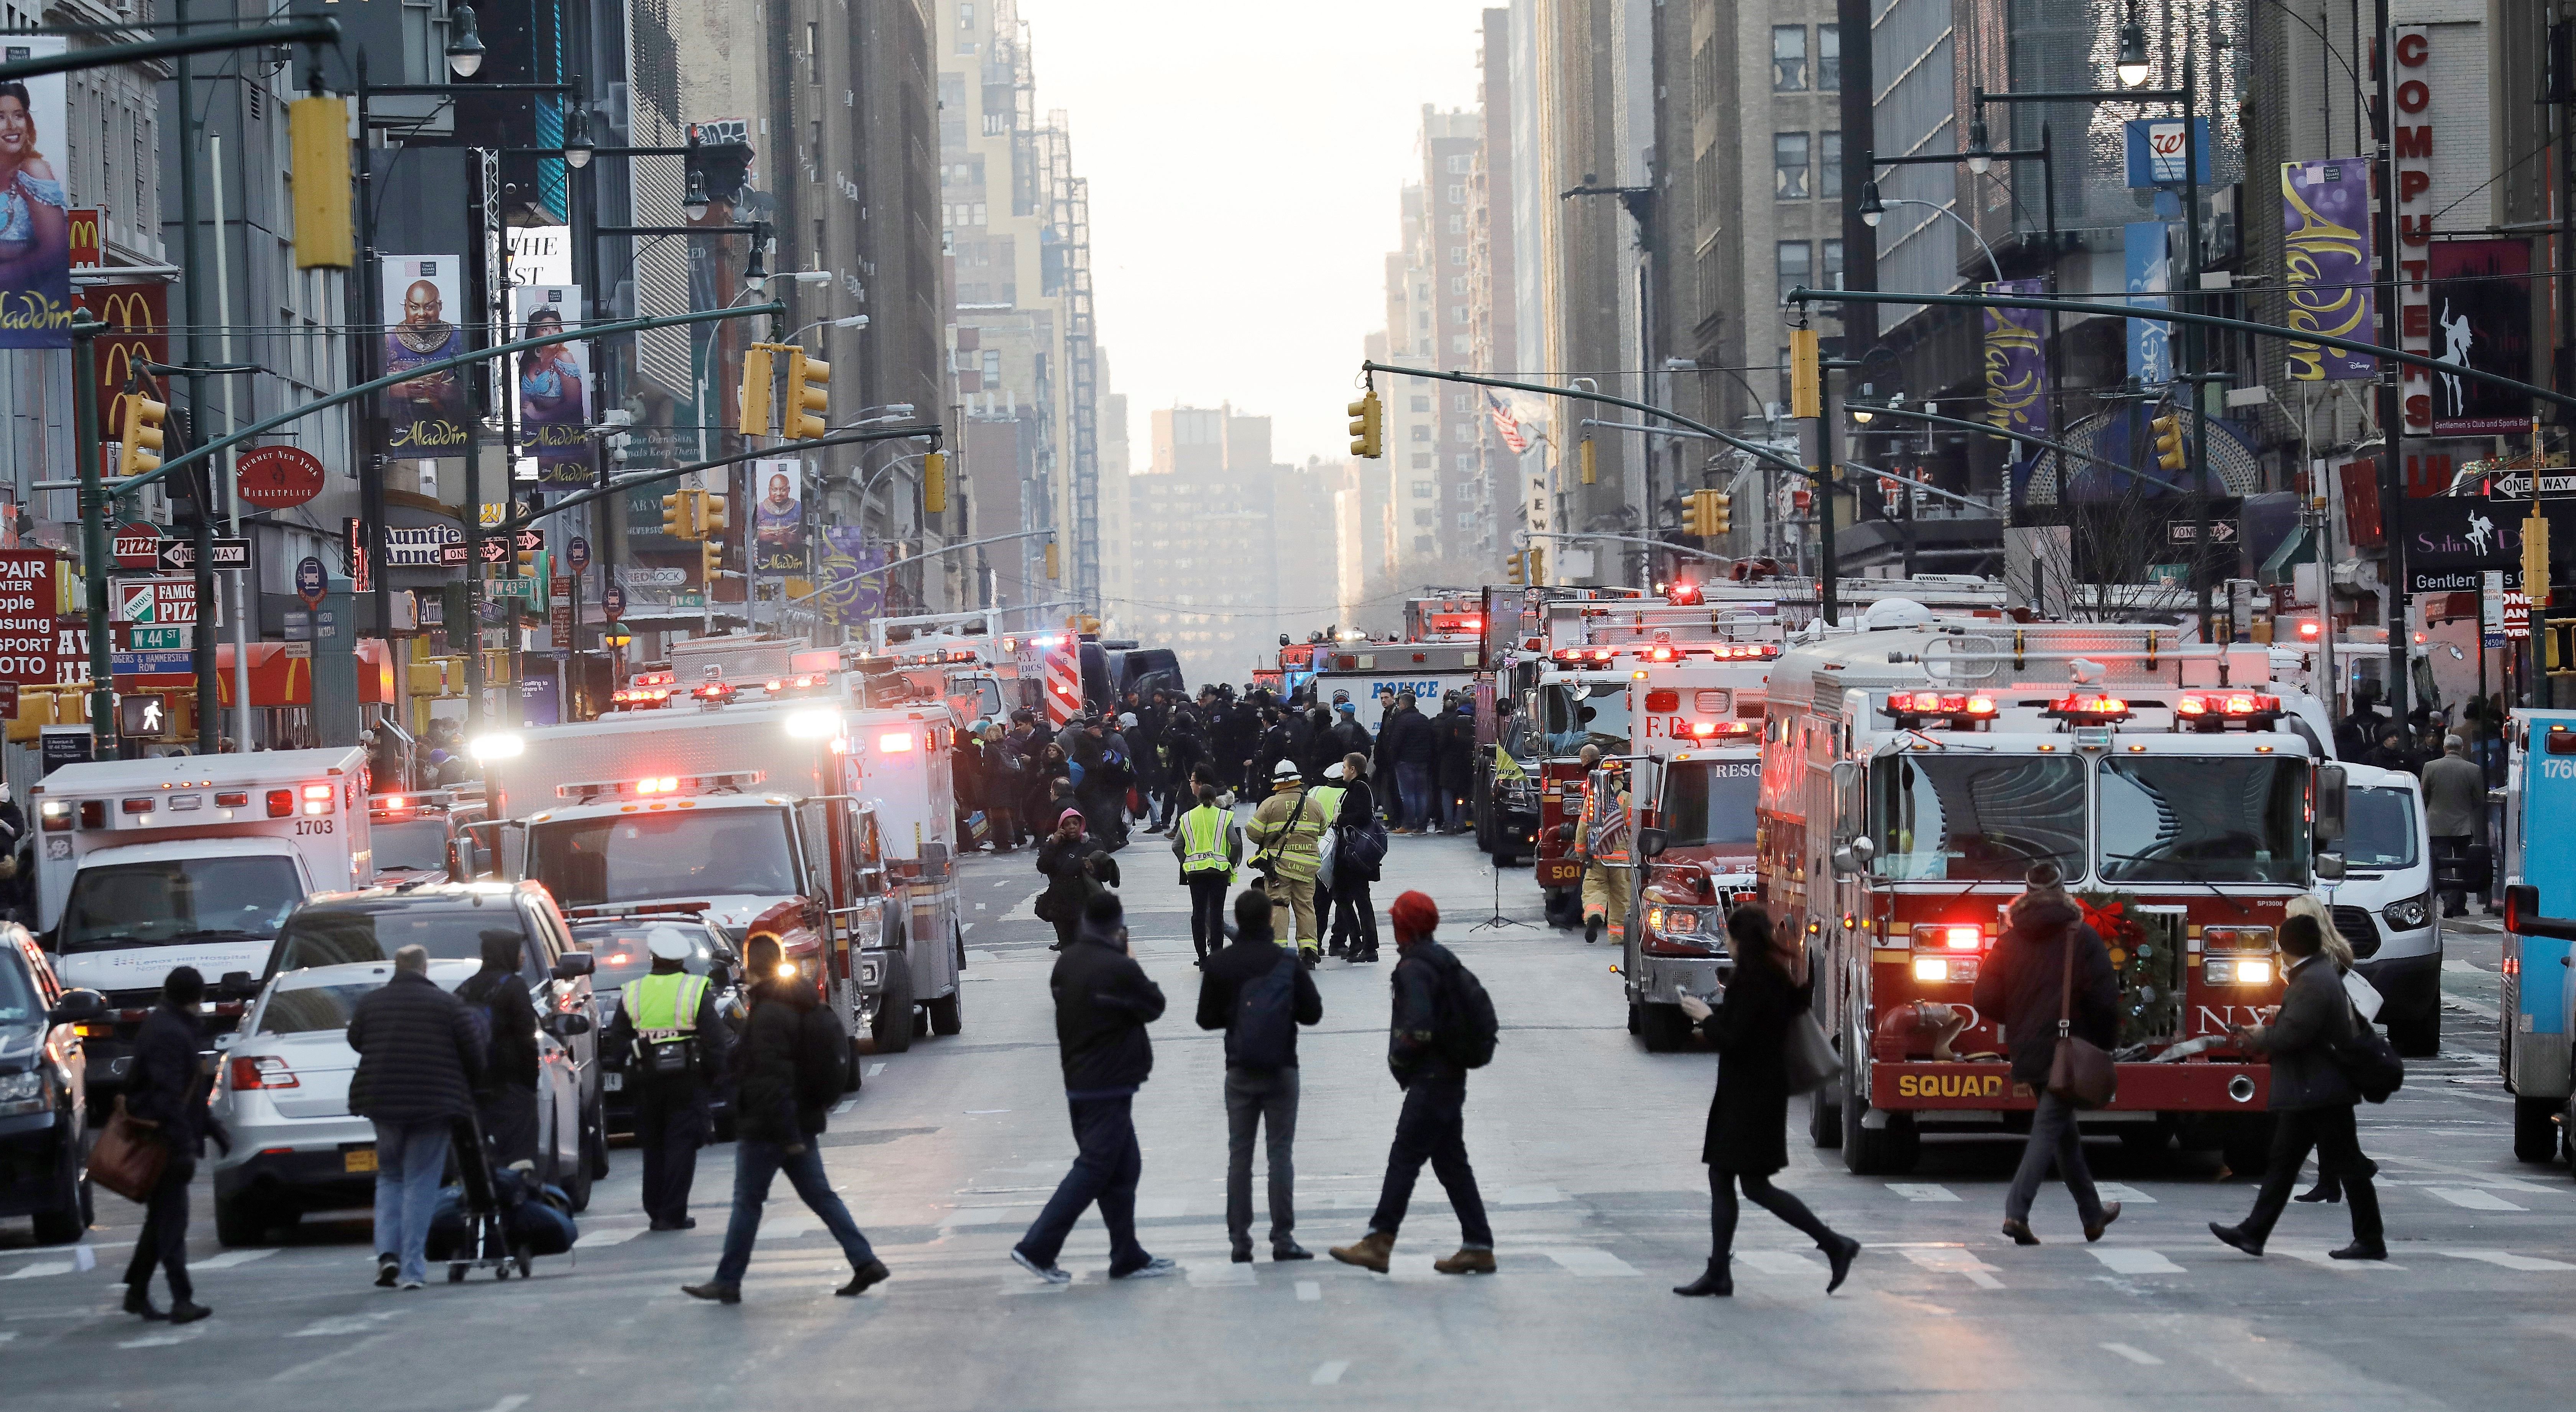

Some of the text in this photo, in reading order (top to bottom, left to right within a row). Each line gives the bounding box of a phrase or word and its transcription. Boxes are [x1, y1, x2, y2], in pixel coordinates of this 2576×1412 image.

[2281, 162, 2364, 381] Aladdin
[2349, 361, 2370, 371] Disney
[2435, 421, 2471, 429] Gentlemen's
[2472, 420, 2485, 428] Club
[2499, 419, 2518, 428] Sports
[389, 419, 468, 447] Aladdin
[521, 424, 586, 447] Aladdin
[537, 463, 594, 483] Aladdin
[2504, 478, 2570, 491] ONE WAY
[2417, 532, 2468, 553] Satin
[758, 554, 803, 570] Aladdin
[496, 582, 503, 594] W
[506, 582, 517, 594] 43
[125, 592, 153, 617] FAMOUS
[134, 629, 177, 647] W 44 ST
[146, 653, 189, 663] HAMMERSTEIN
[139, 663, 155, 672] ROW
[1285, 801, 1307, 810] FDY
[296, 819, 334, 836] 1703
[1899, 1075, 2003, 1097] SQUAD
